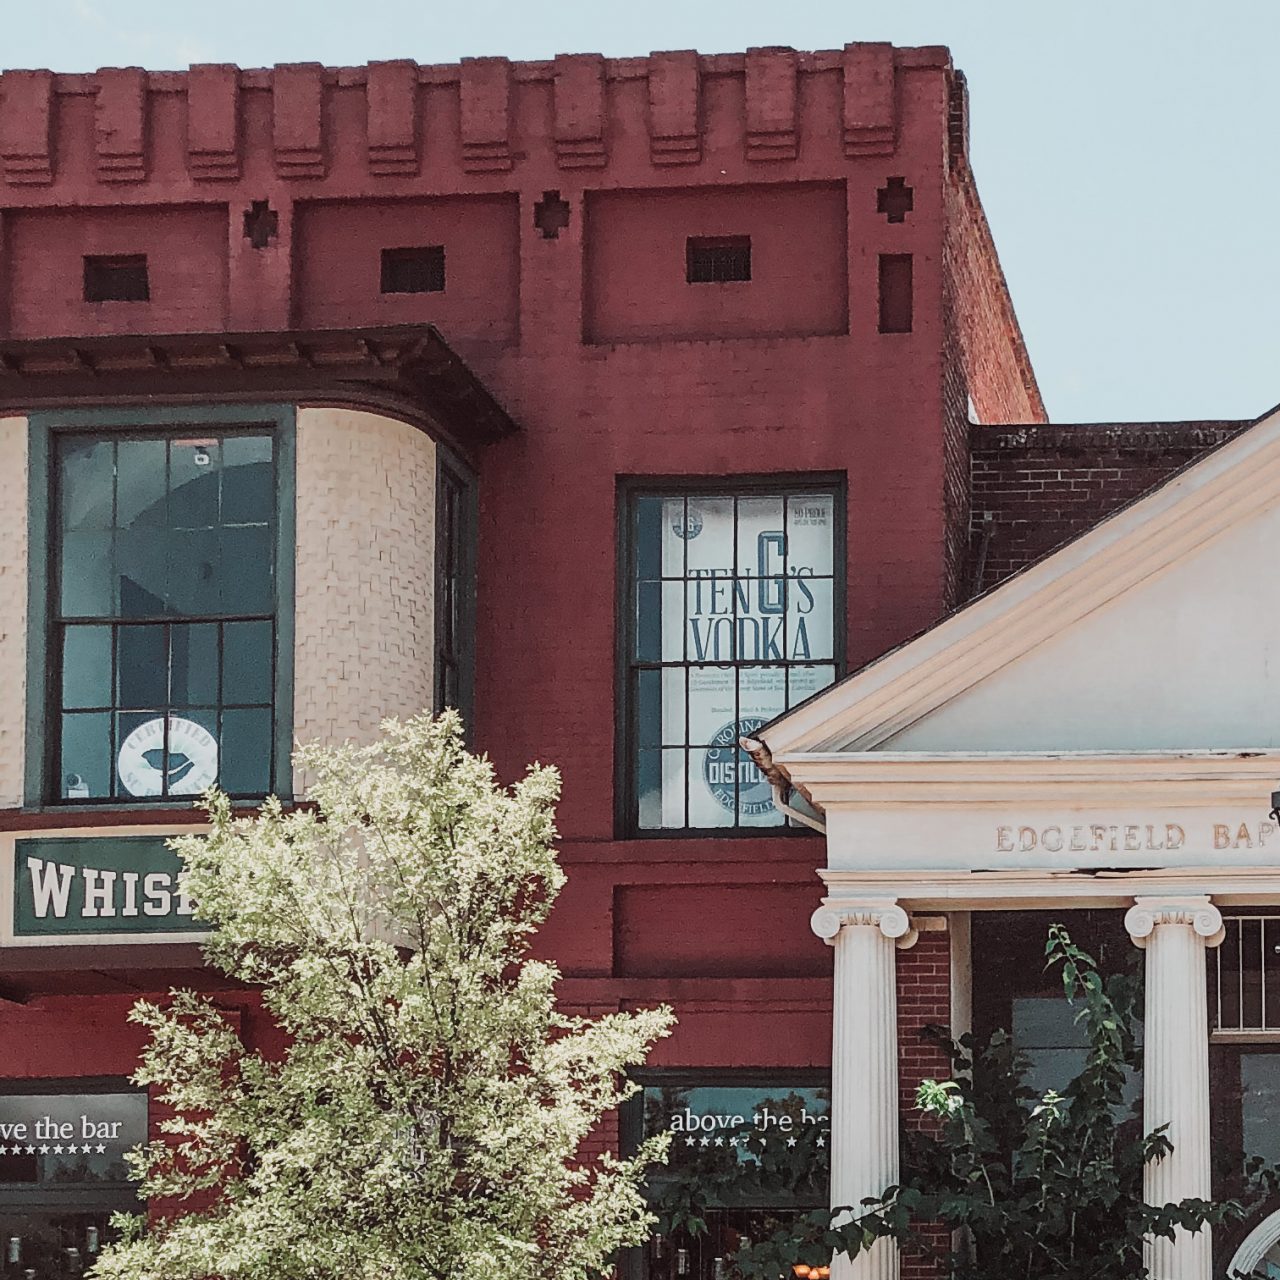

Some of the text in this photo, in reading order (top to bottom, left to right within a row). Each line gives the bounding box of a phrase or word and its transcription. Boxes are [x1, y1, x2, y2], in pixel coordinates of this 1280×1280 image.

[690, 616, 816, 670] VODKA
[996, 823, 1186, 851] EDGEFIELD
[35, 1115, 74, 1139] the
[80, 1115, 122, 1138] bar
[670, 1108, 745, 1132] above
[753, 1108, 793, 1131] the
